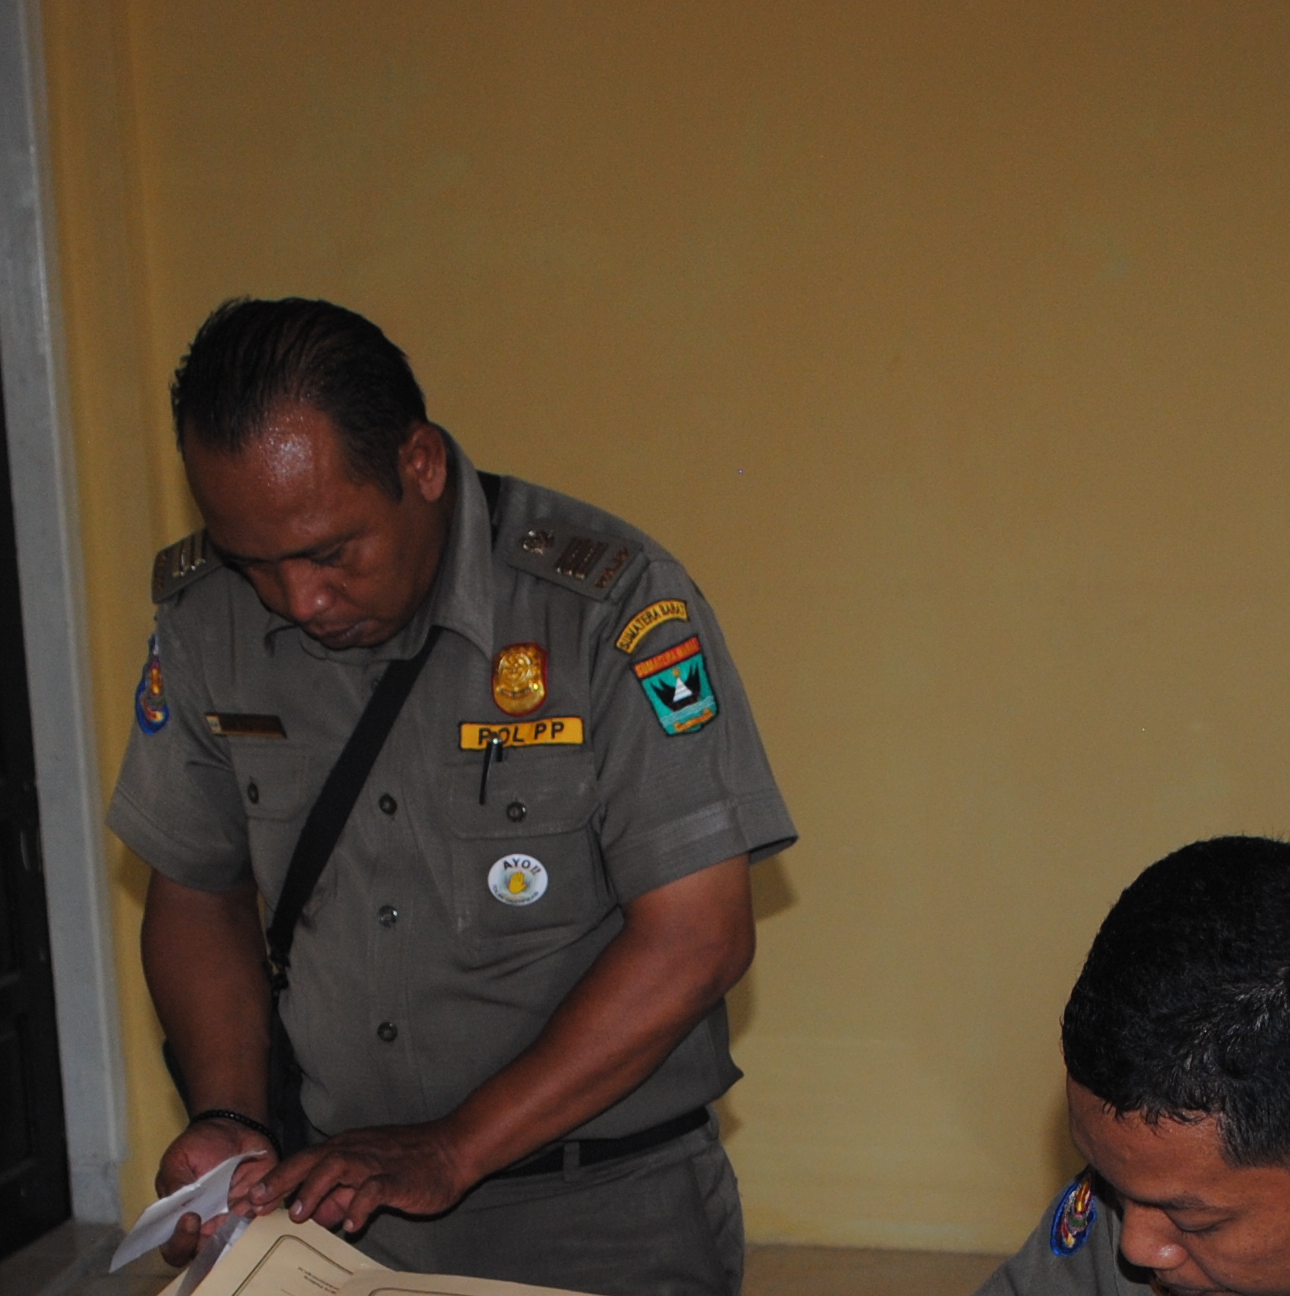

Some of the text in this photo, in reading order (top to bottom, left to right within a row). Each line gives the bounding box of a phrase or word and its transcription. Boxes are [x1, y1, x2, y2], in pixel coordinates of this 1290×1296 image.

[620, 601, 686, 650] SUMATERA BARAT
[478, 721, 565, 745] POL PP
